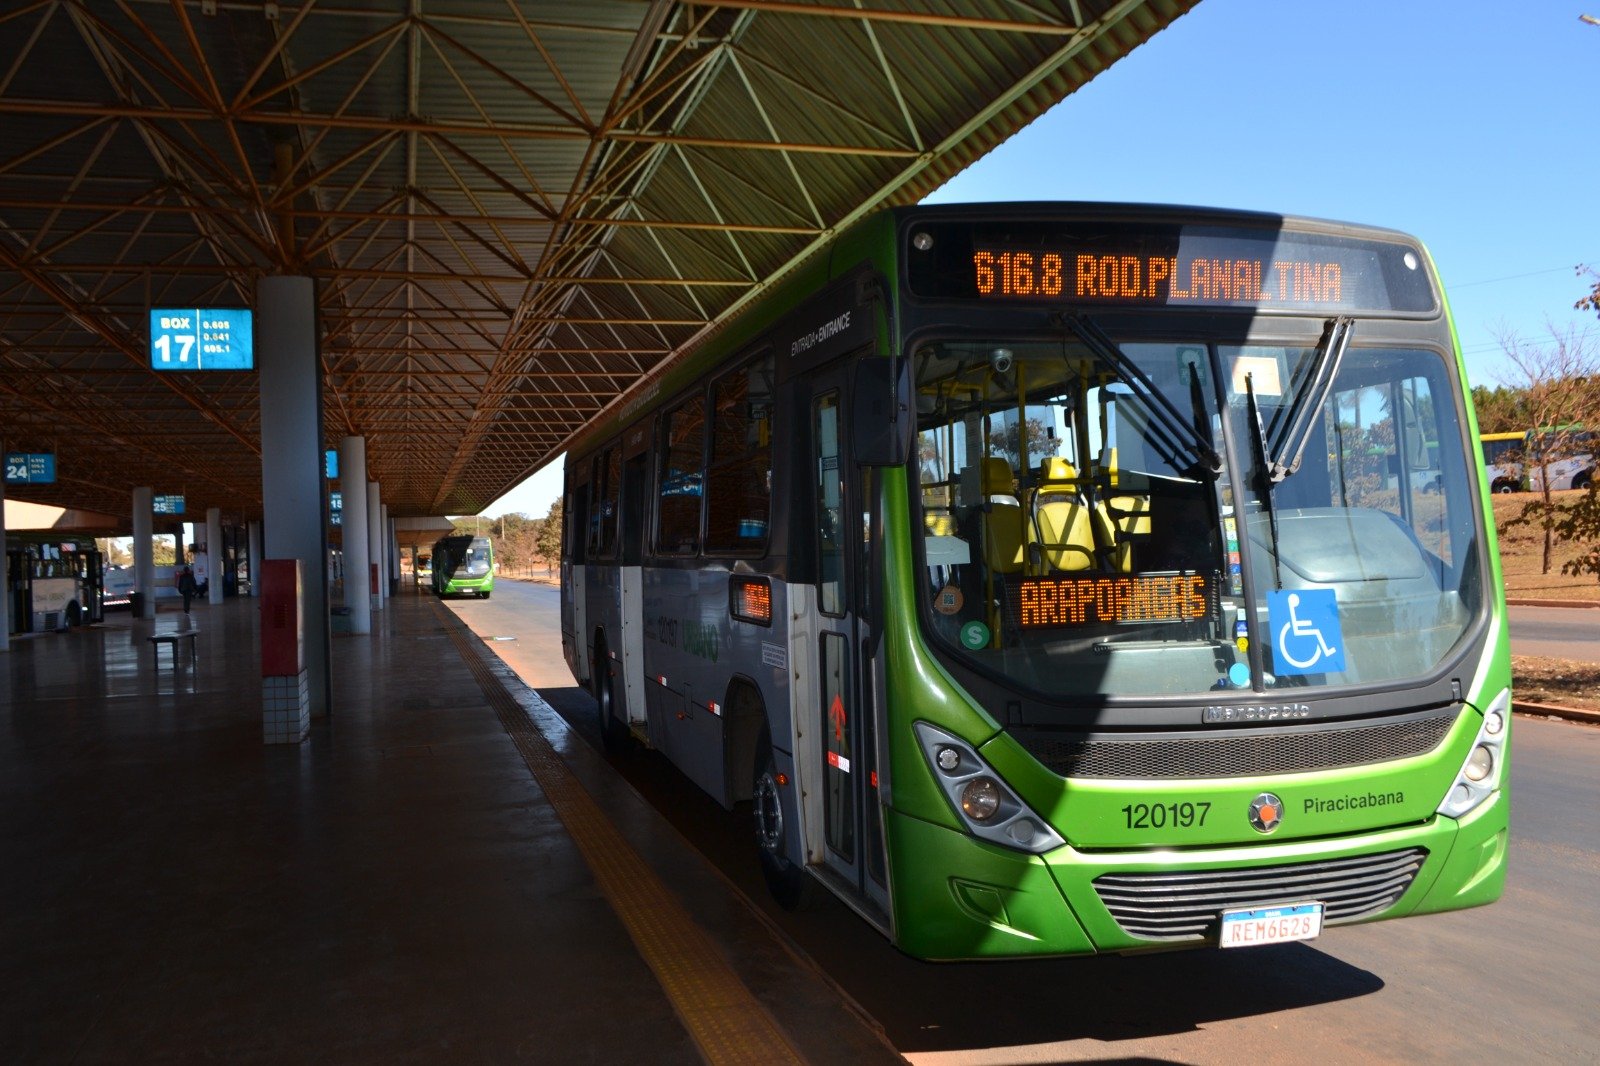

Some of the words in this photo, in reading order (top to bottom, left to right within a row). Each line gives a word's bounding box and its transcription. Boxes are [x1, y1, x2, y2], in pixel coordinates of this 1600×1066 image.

[974, 251, 1064, 295] 616.8
[160, 317, 190, 329] BOX
[791, 331, 816, 357] ENTRADA
[818, 310, 851, 343] ENTRANCE
[154, 334, 196, 362] 17
[6, 465, 28, 479] 24
[153, 502, 165, 513] 25
[1021, 576, 1206, 624] ARAPOANGAS
[967, 625, 983, 645] S
[1303, 791, 1405, 814] Piracicabana
[1121, 802, 1212, 829] 120197
[1231, 917, 1311, 942] REM6G28
